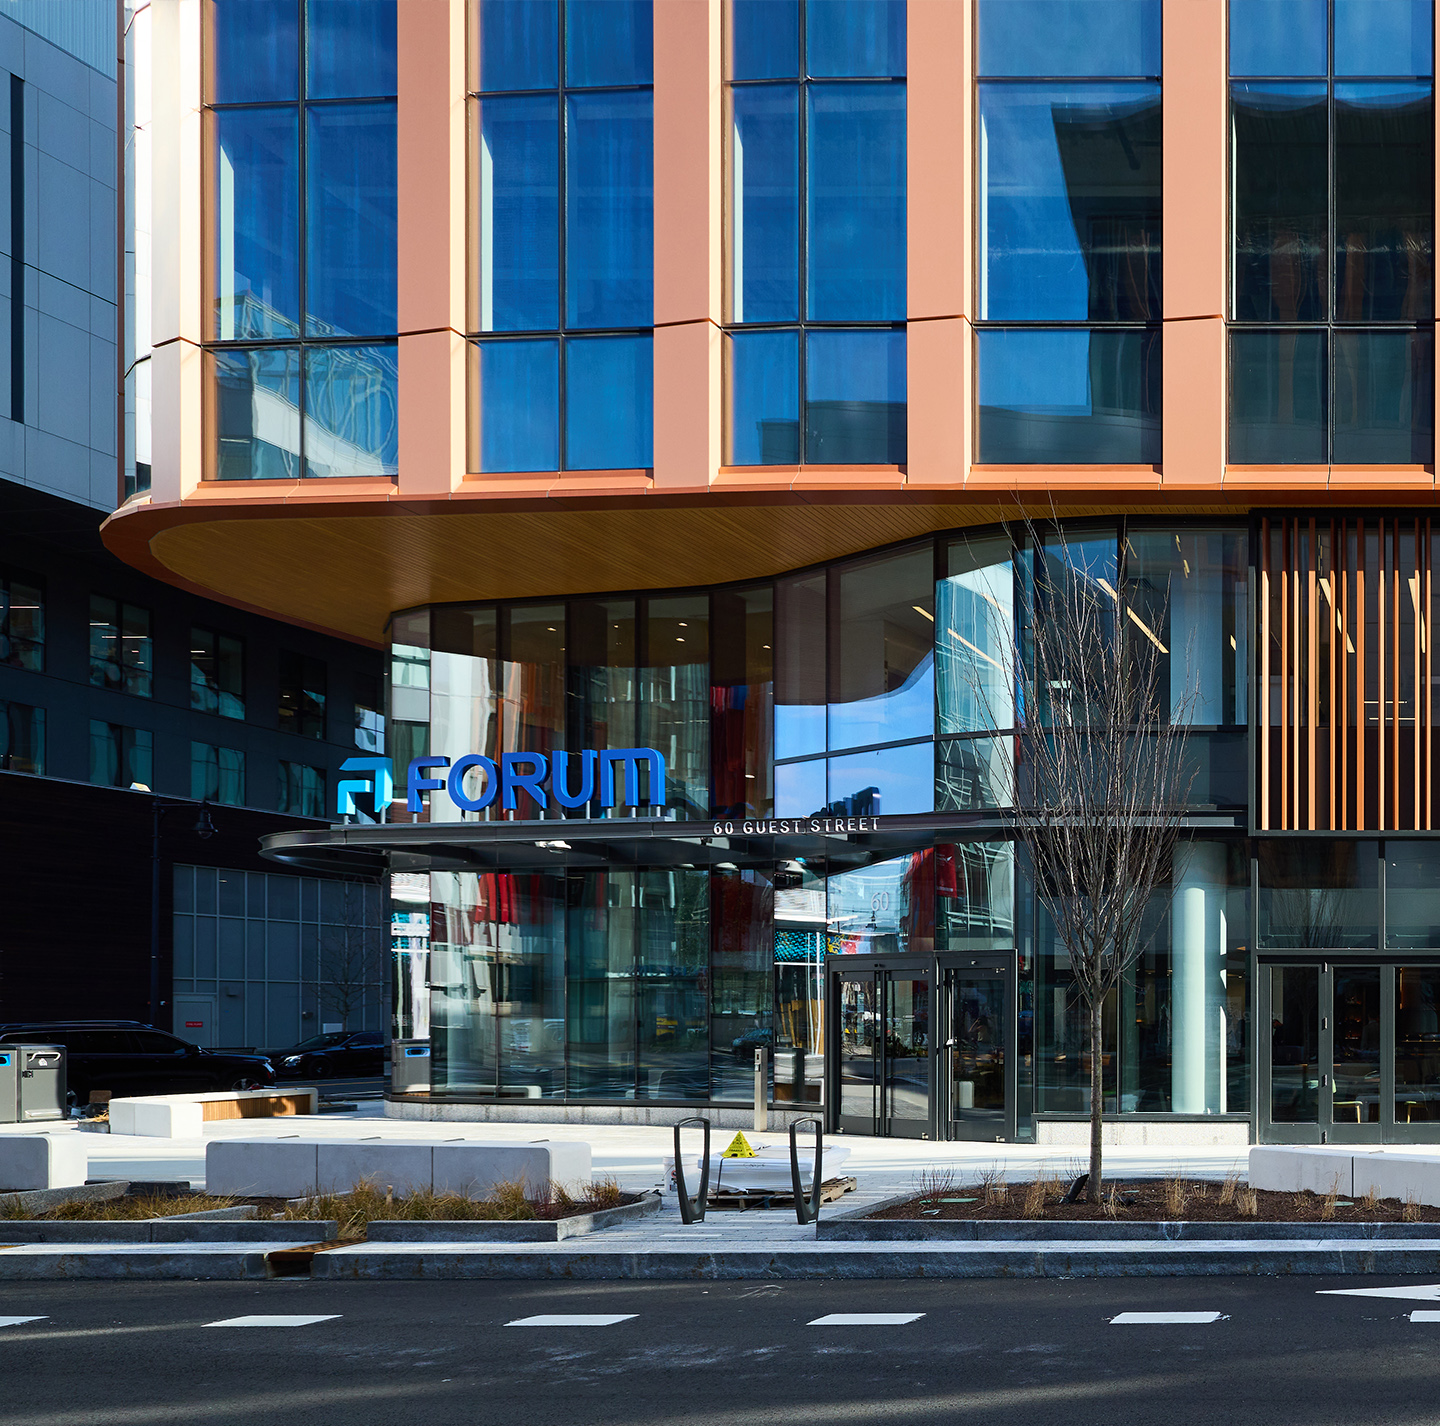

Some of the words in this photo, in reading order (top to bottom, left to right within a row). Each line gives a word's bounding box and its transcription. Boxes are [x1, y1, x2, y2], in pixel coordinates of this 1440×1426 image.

[407, 747, 666, 813] FORUM
[712, 821, 734, 836] 60
[742, 819, 801, 835] GUEST
[810, 817, 880, 833] STREET
[870, 891, 890, 912] 60
